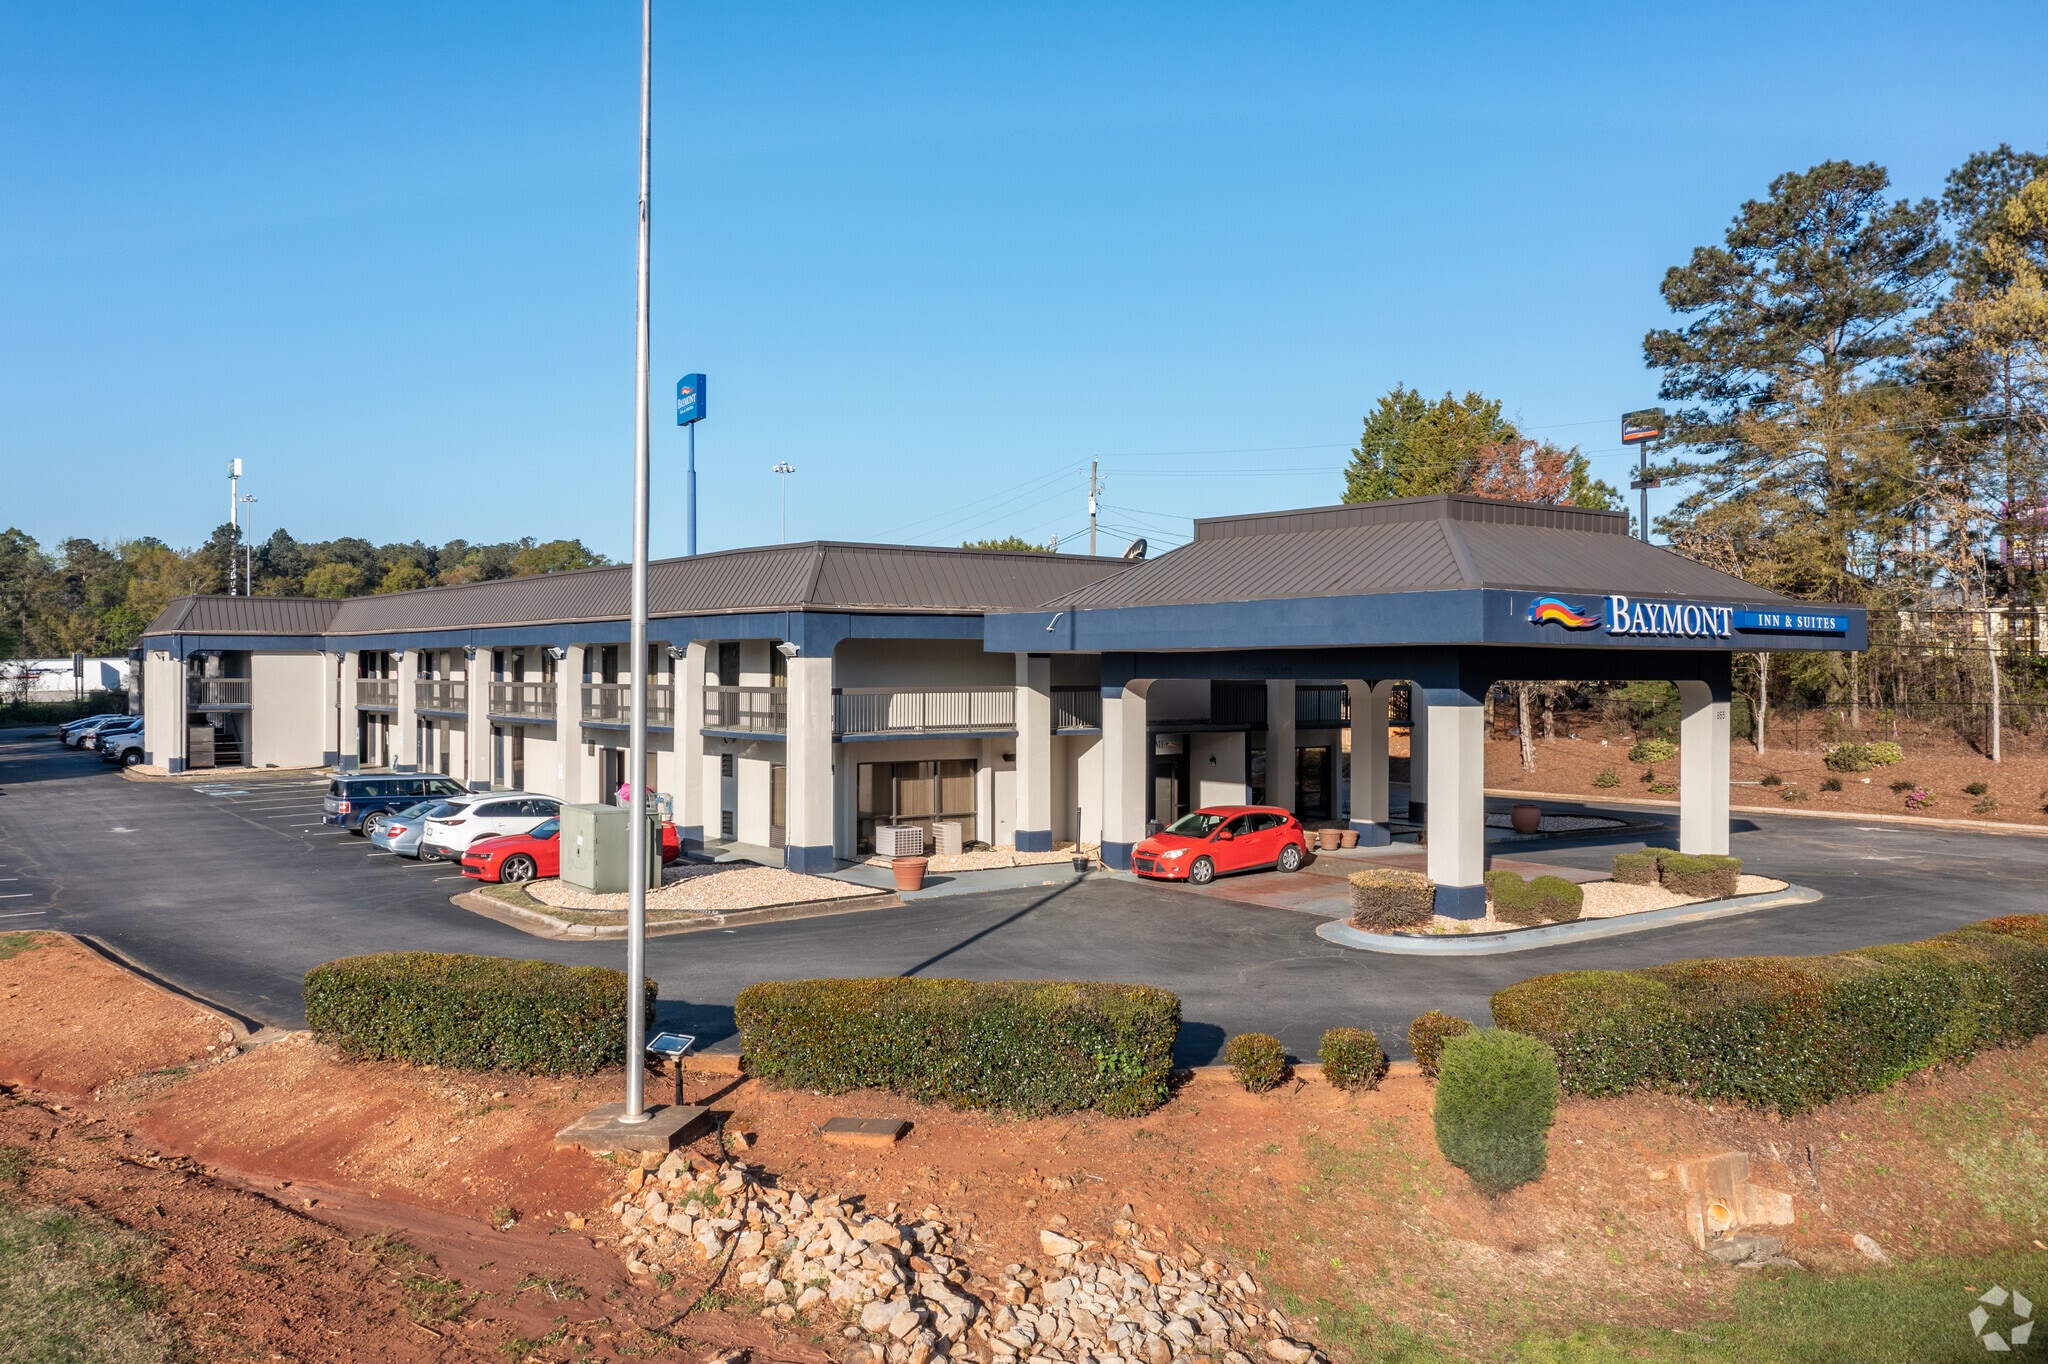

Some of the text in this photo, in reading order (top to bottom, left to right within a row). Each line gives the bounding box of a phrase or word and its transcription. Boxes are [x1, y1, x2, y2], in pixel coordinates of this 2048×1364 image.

[1607, 595, 1733, 637] BAYMONT
[1758, 614, 1836, 630] INN & SUITES
